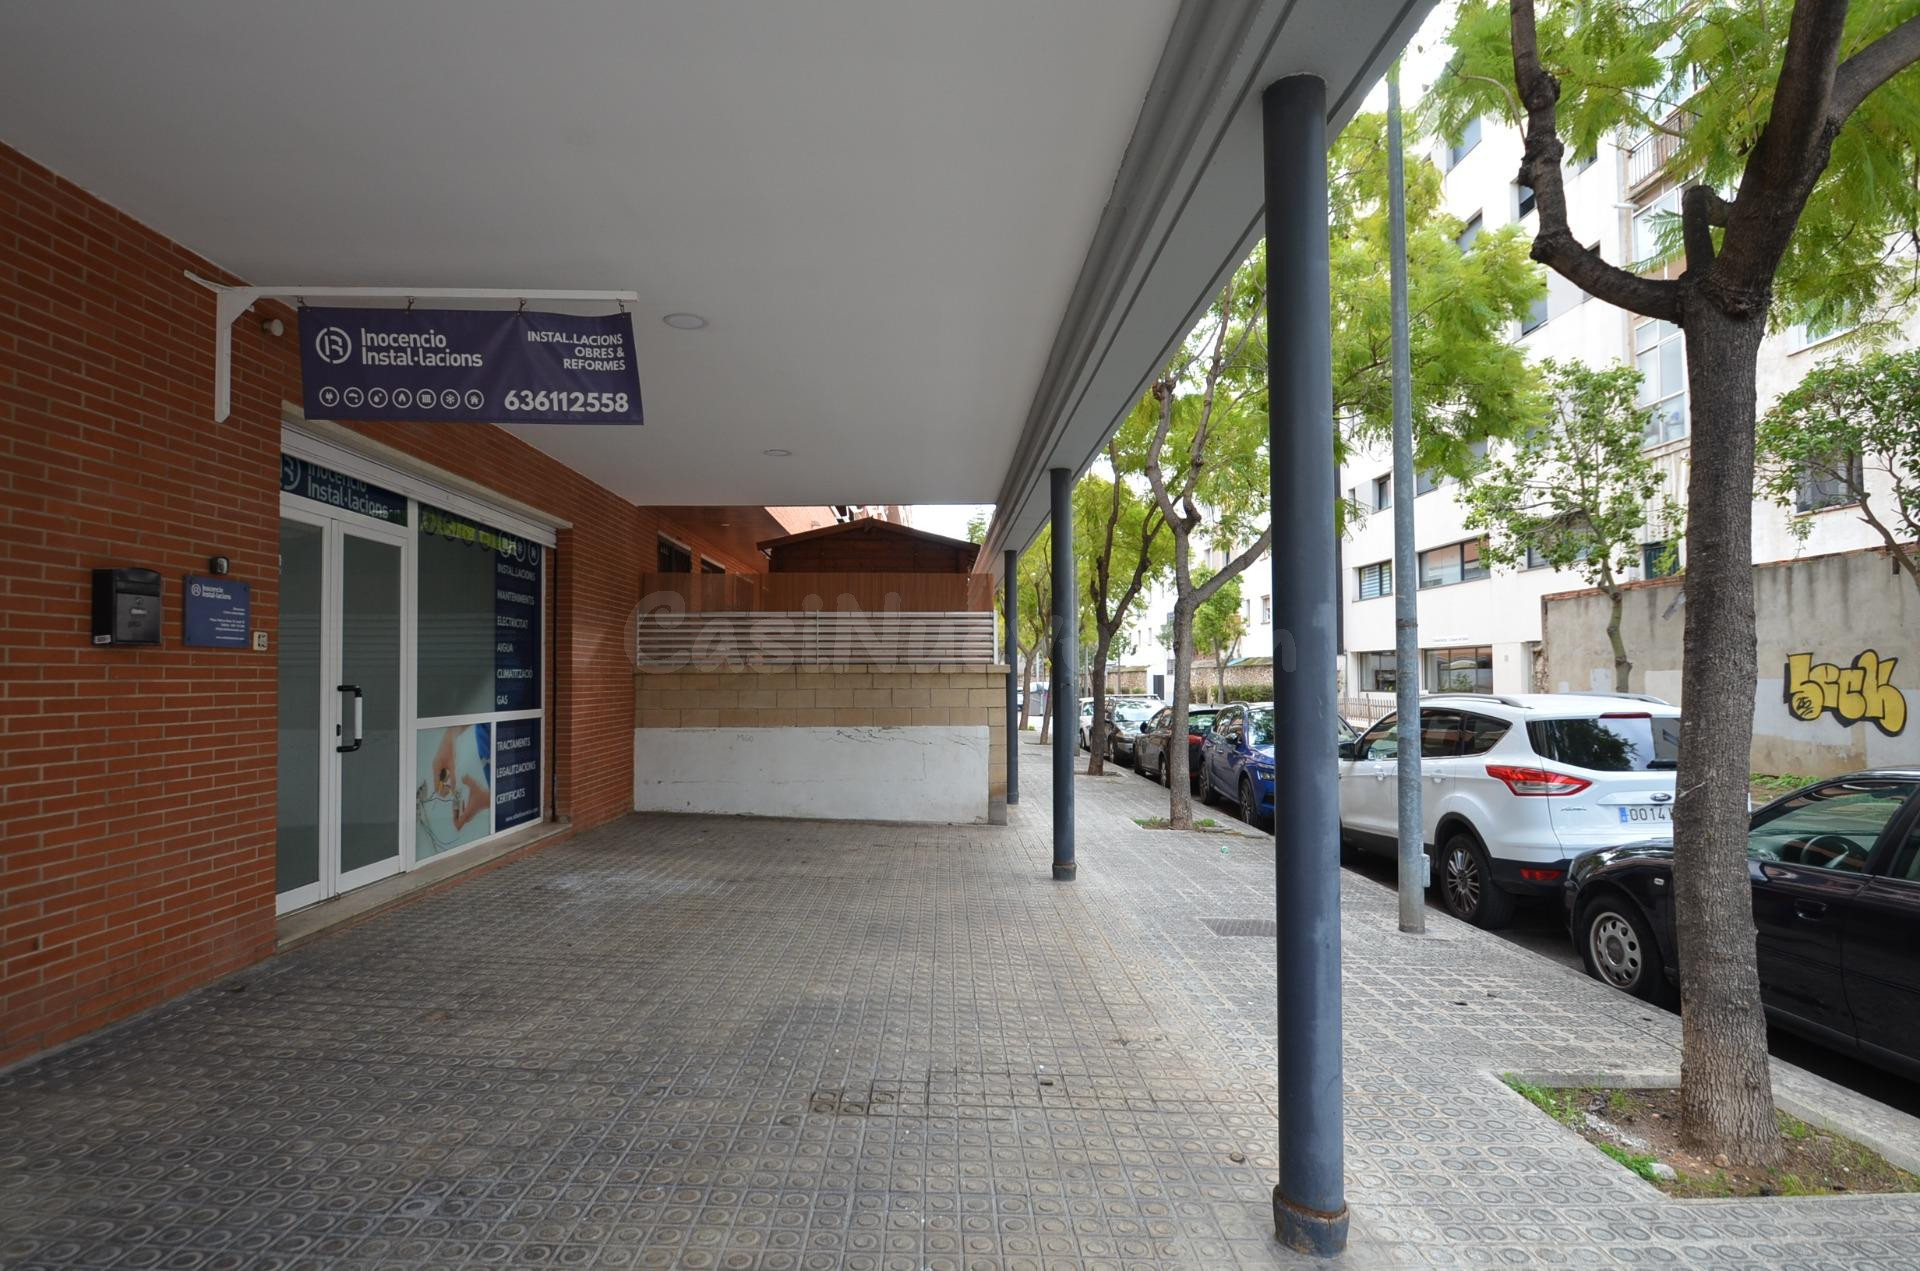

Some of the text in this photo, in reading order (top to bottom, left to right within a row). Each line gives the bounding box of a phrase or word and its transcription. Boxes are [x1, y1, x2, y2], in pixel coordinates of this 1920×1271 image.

[361, 328, 447, 348] Inocencio
[361, 346, 483, 367] Instal·lacions
[574, 347, 625, 359] OBRES &
[563, 358, 626, 371] REFORMES
[504, 390, 629, 413] 636112558
[496, 695, 509, 705] GAS
[1629, 808, 1666, 821] 0014
